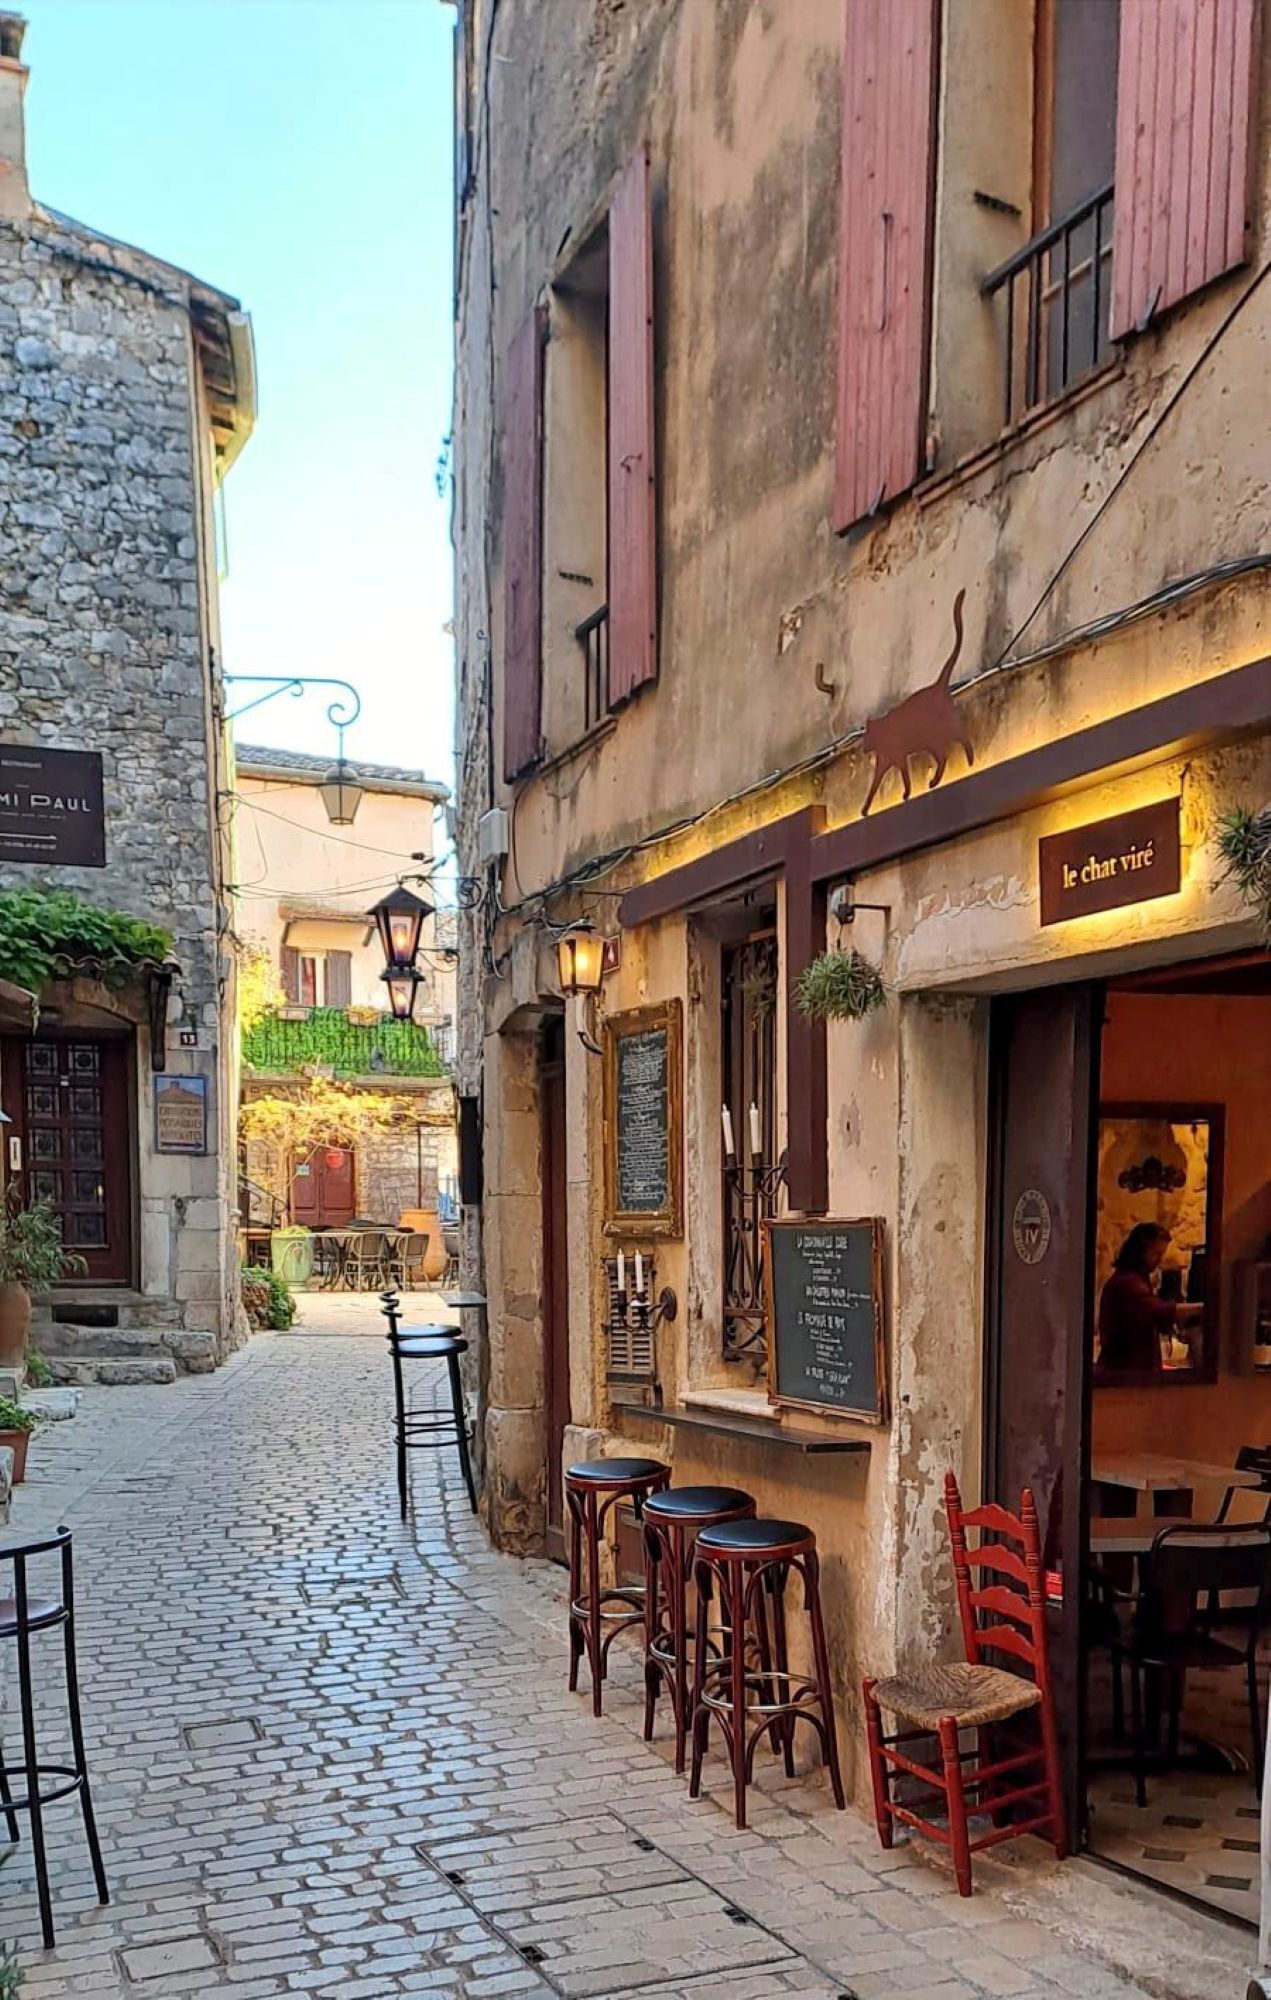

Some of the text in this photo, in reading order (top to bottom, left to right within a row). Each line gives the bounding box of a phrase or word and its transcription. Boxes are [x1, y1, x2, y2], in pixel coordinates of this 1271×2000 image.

[30, 794, 91, 812] PAUL
[1063, 840, 1154, 889] le chat viré
[182, 1034, 195, 1045] 13
[1025, 1228, 1039, 1244] IV
